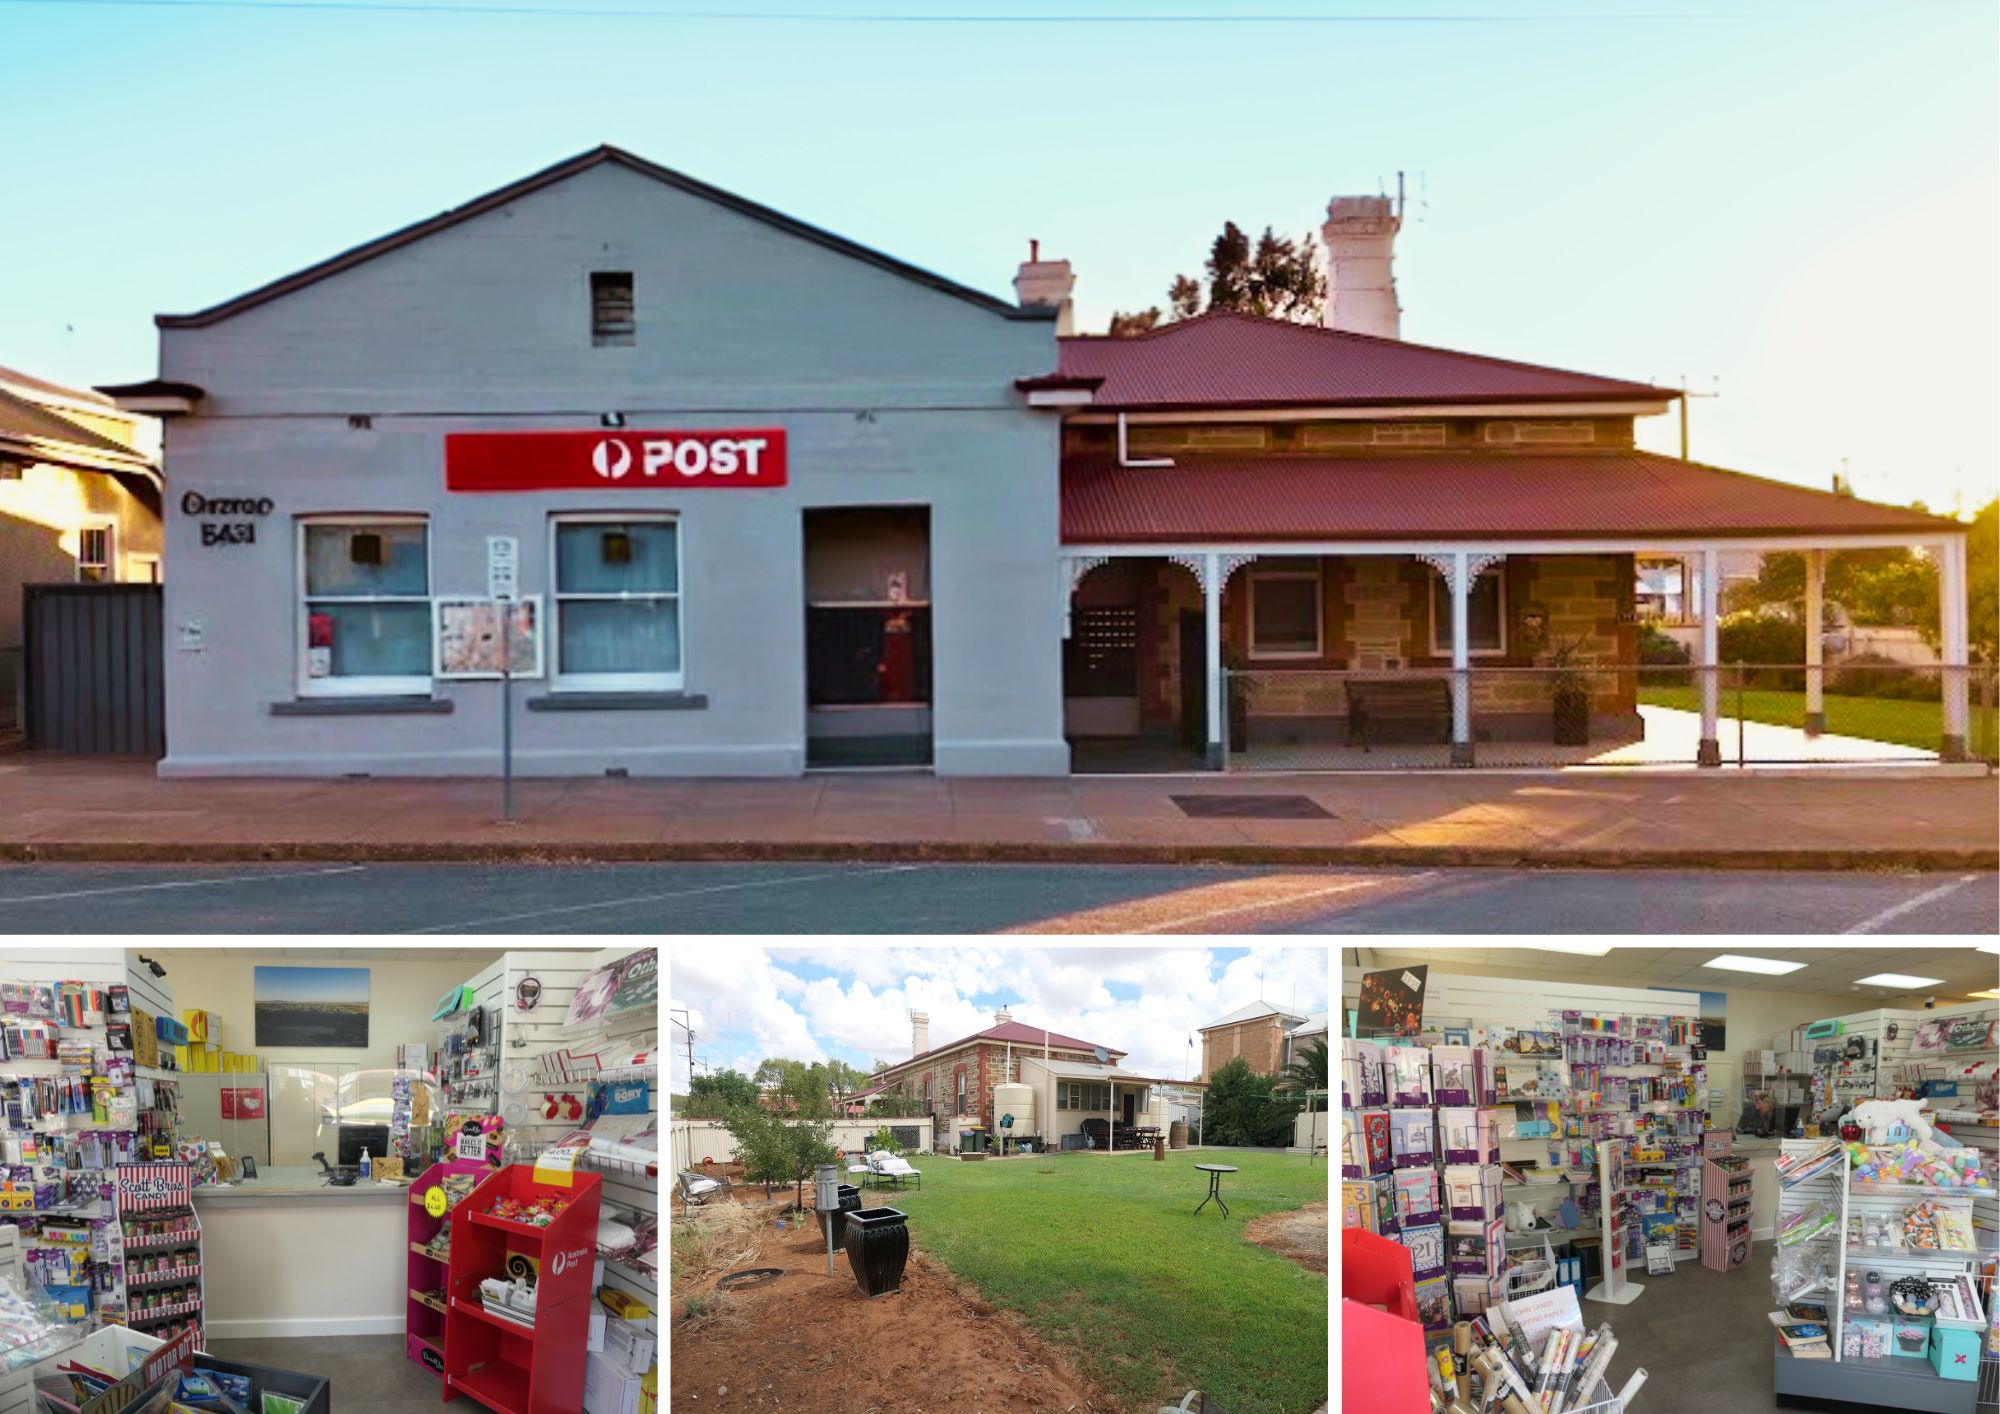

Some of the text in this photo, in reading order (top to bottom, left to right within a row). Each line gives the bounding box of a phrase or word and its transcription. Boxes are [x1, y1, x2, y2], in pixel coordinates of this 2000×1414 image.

[643, 438, 767, 476] POST
[121, 1177, 151, 1192] Scott
[134, 1192, 168, 1200] CANDY
[567, 1248, 588, 1258] Australia
[1414, 1241, 1432, 1258] 21
[566, 1258, 578, 1268] Post
[150, 1347, 178, 1383] MOTOR
